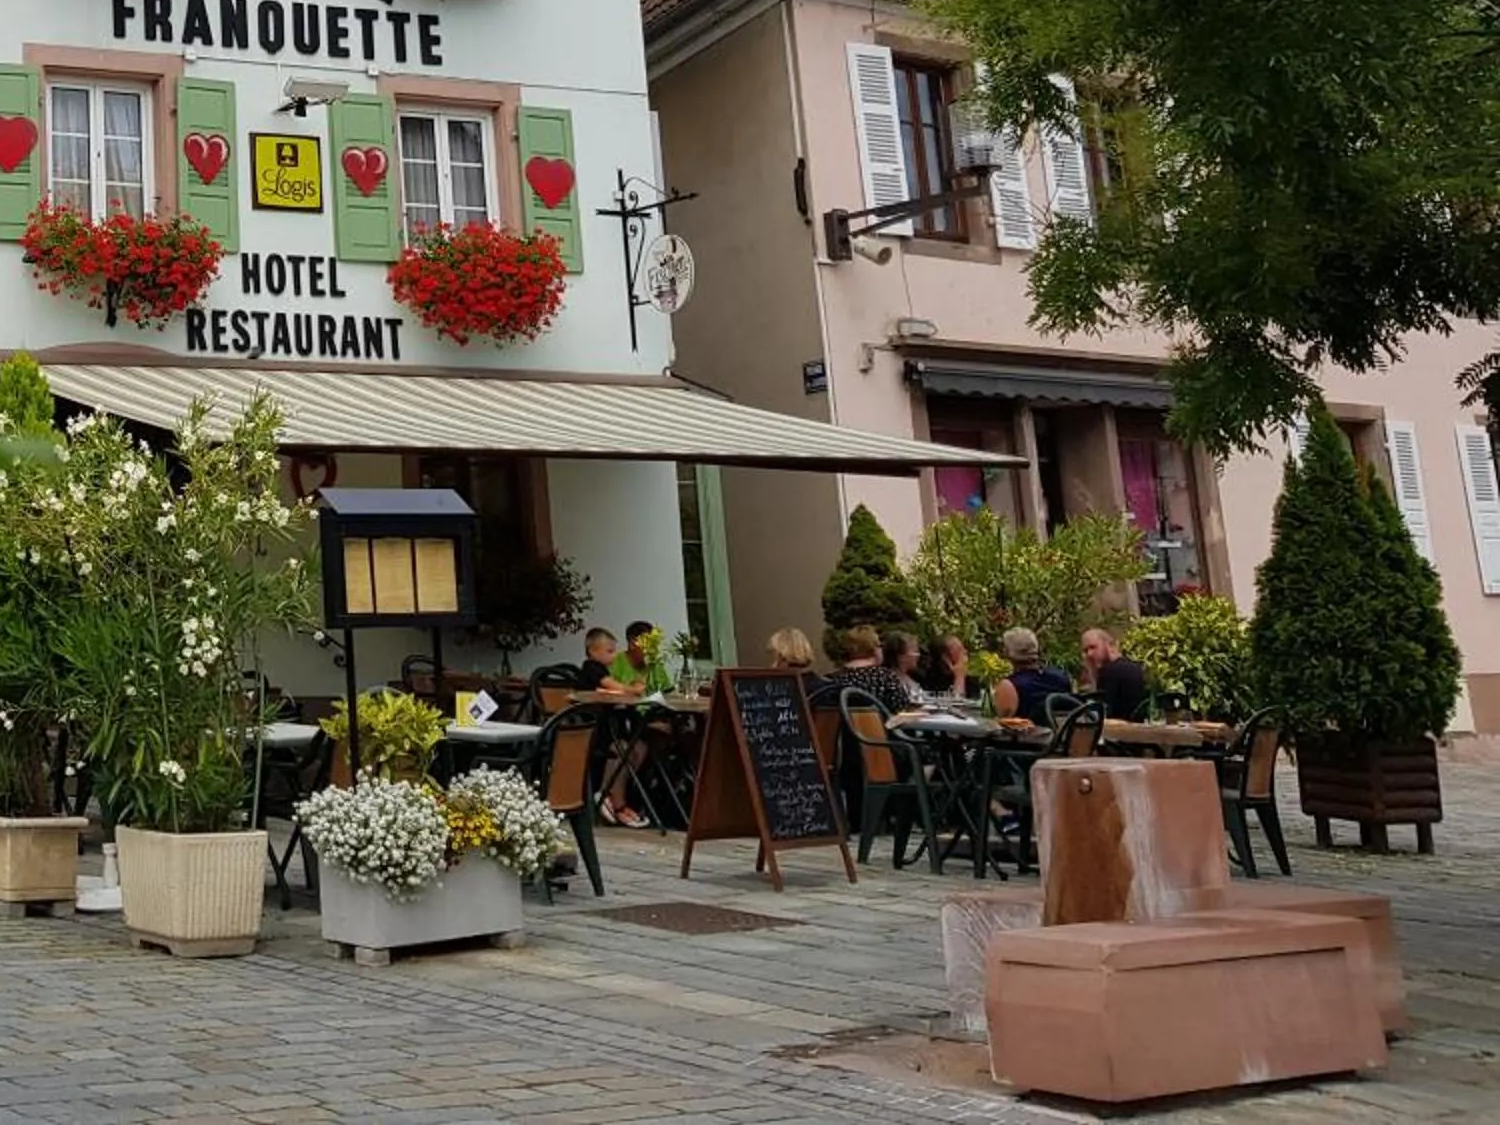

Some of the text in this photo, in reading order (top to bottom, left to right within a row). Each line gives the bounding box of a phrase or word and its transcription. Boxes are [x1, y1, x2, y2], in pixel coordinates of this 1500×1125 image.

[260, 166, 317, 203] Logis
[241, 252, 346, 298] HOTEL
[186, 308, 403, 360] RESTAURANT
